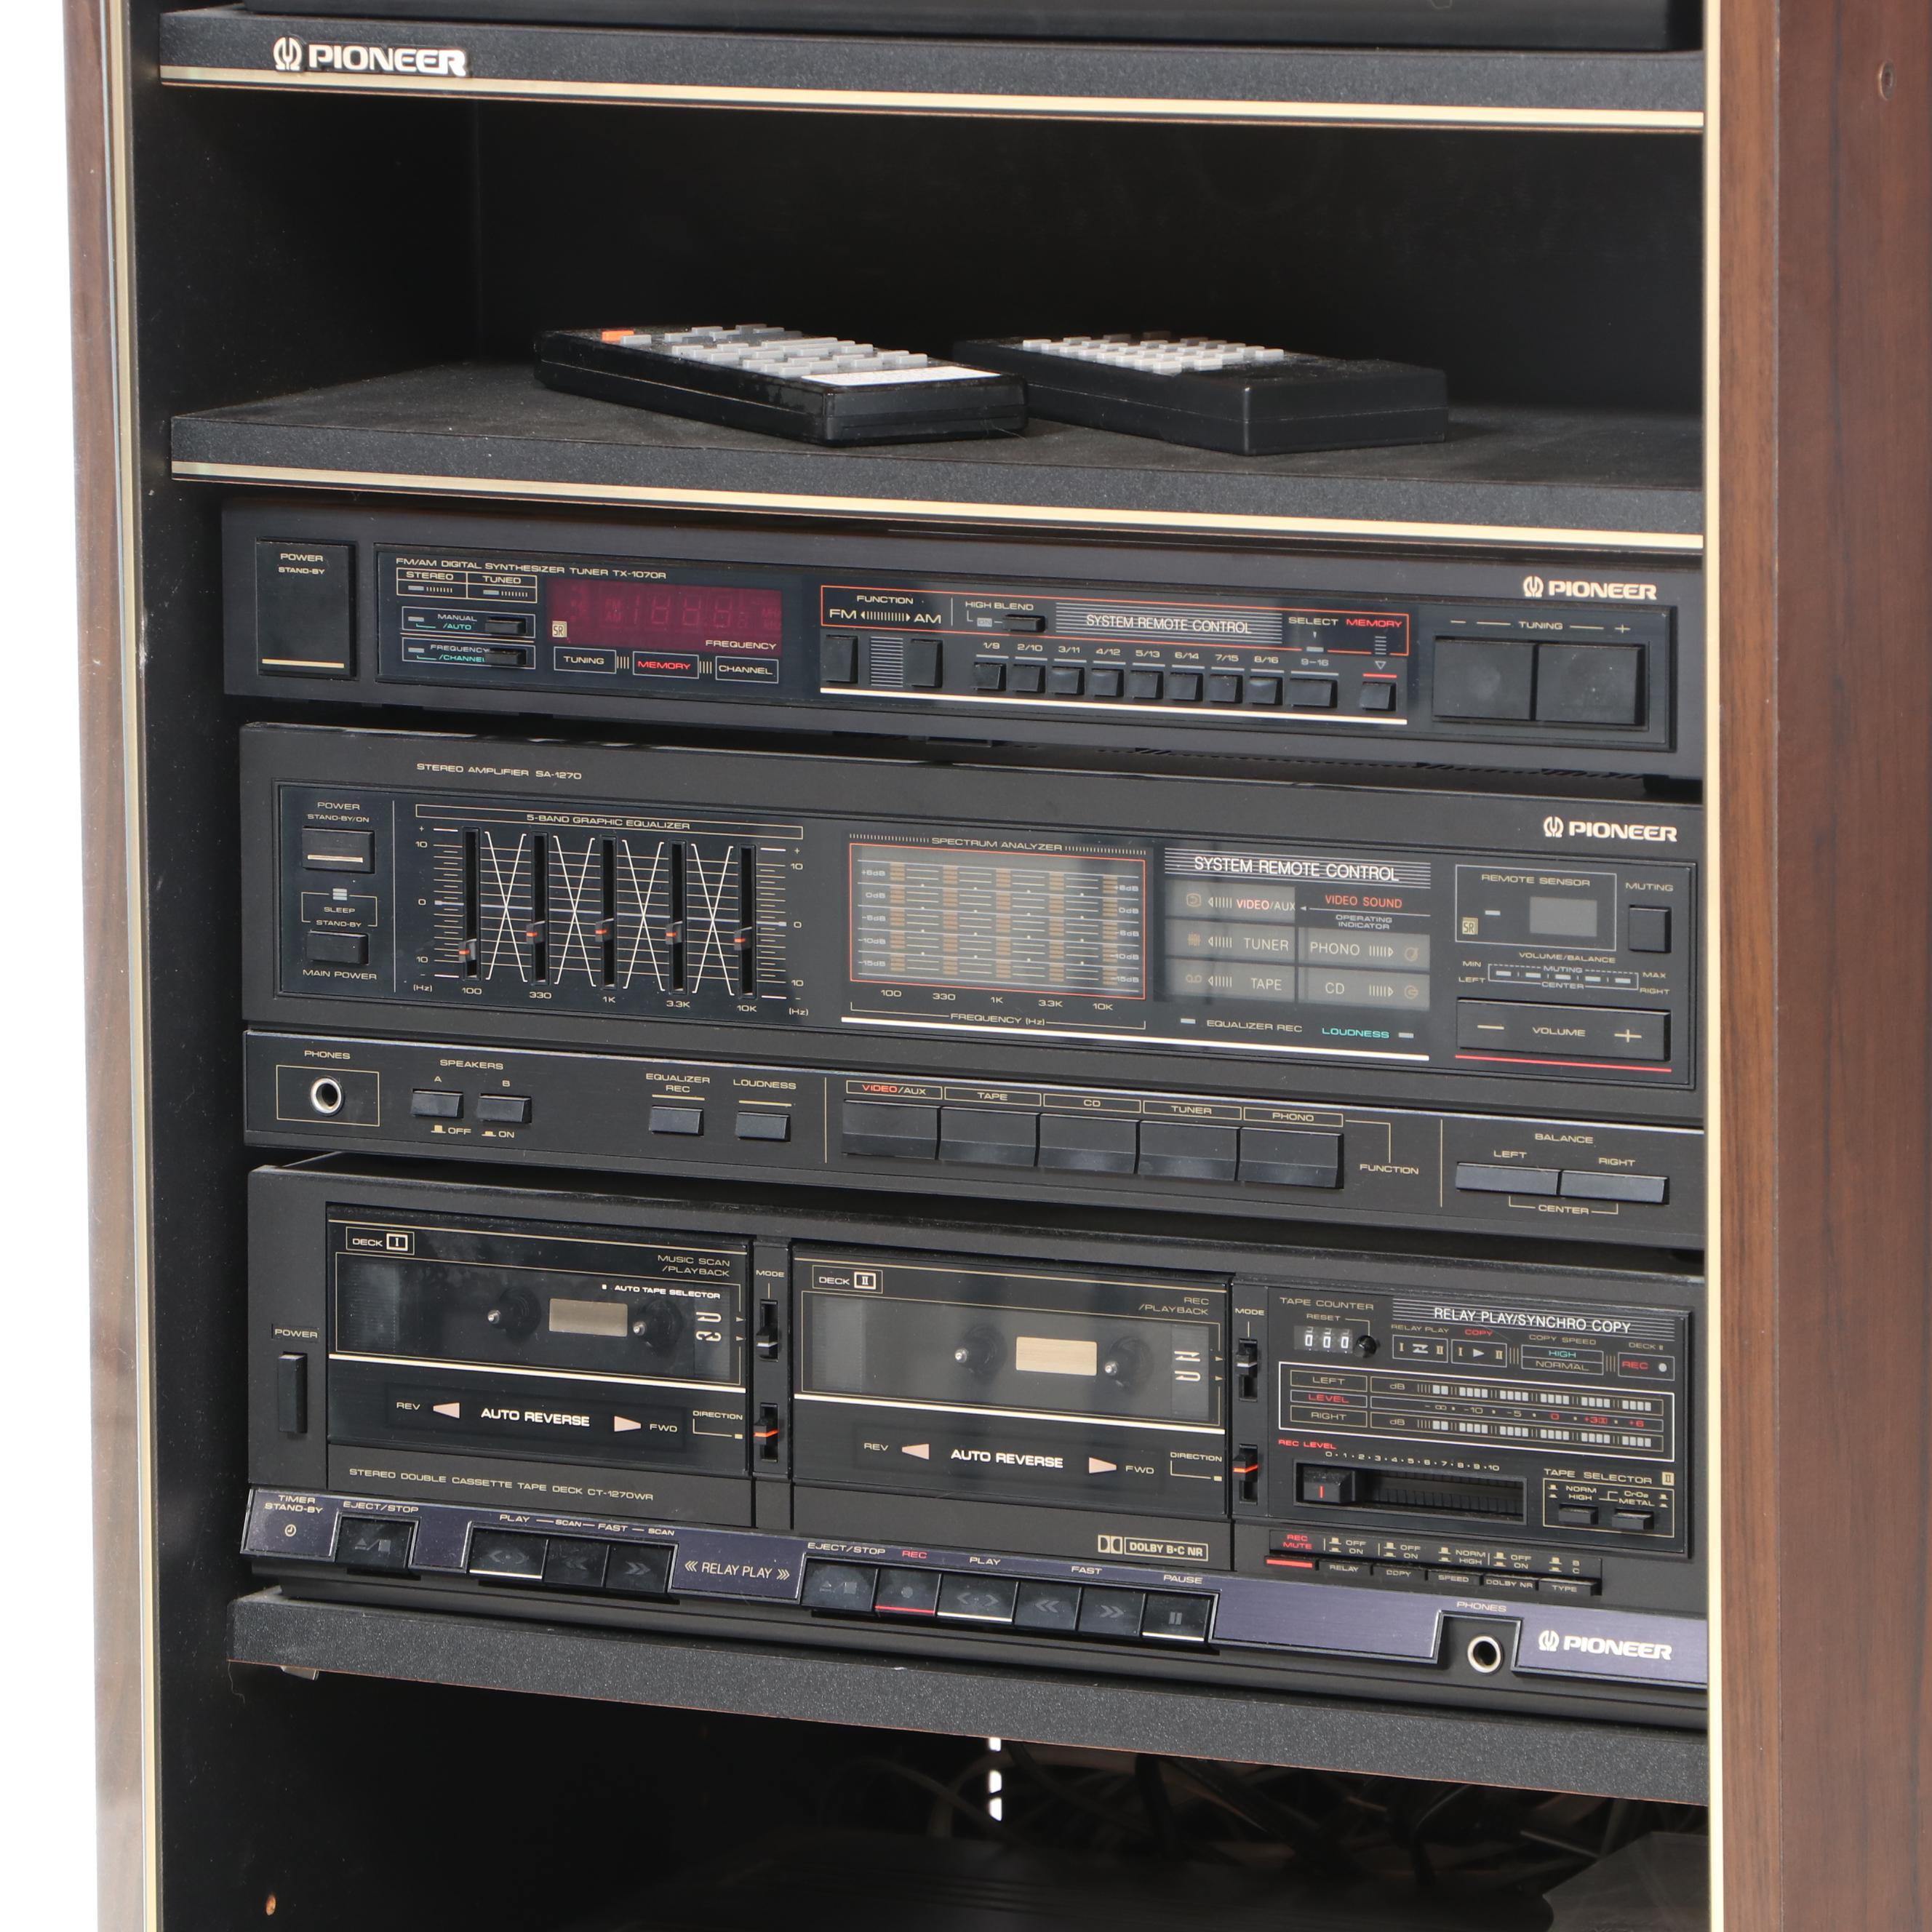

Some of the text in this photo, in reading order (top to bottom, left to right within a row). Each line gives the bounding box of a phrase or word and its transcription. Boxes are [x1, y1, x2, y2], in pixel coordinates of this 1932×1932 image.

[309, 44, 466, 76] PIONEER
[442, 561, 482, 569] DIGITAL
[485, 563, 564, 573] SYNTHESIZER
[570, 567, 608, 575] TUNER
[612, 570, 666, 579] TX-1070R
[406, 572, 453, 580] STEREO
[482, 576, 521, 584] TUNED
[1549, 580, 1657, 600] PIONEER
[857, 595, 913, 604] FUNCTION
[830, 609, 857, 618] FM
[914, 614, 941, 623] AM
[1087, 615, 1252, 634] SYSTEM REMOTE CONTROL
[1288, 617, 1338, 626] SELECT
[1346, 619, 1402, 627] MEMORY
[1518, 621, 1563, 630] TUNING
[431, 644, 490, 652] FREQUENCY
[706, 640, 777, 650] FREQUENCY
[1018, 644, 1042, 652] 2/10
[563, 656, 604, 664] TUNING
[638, 660, 691, 670] MEMORY
[719, 665, 773, 674] CHANNEL
[417, 764, 582, 780] STEREO AMPLIFIER SA-1270
[317, 802, 360, 810] POWER
[308, 814, 369, 822] STAND-BY/ON
[527, 815, 690, 829] 5-BAND GRAPHIC EQUALIZER
[1569, 821, 1677, 842] PIONEER
[931, 838, 1062, 851] SPECTRUM ANALYZER
[1194, 856, 1399, 881] SYSTEM REMOTE CONTROL
[1482, 874, 1590, 886] REMOTE SENSOR
[1626, 882, 1673, 891] MUTING
[1237, 898, 1295, 911] VIDEO/AUX
[1325, 895, 1402, 908] VIDEO SOUND
[1336, 914, 1392, 922] OPERATING
[1244, 938, 1288, 951] TUNER
[1310, 942, 1360, 956] PHONO
[1520, 952, 1616, 963] VOLUME/BALANCE
[335, 971, 377, 980] POWER
[1251, 978, 1282, 991] TAPE
[1325, 982, 1344, 994] CD
[951, 1013, 1021, 1024] FREQUENCY
[1207, 1020, 1302, 1033] EQUALIZER REC
[1322, 1028, 1389, 1038] LOUDNESS
[1533, 1027, 1586, 1037] VOLUME
[304, 1050, 351, 1059] PHONES
[440, 1059, 503, 1070] SPEAKERS
[646, 1073, 710, 1083] EQUALIZER
[666, 1085, 690, 1093] REC
[733, 1079, 797, 1090] LOUDNESS
[862, 1085, 926, 1095] VIDEO/AUX
[978, 1092, 1007, 1101] TAPE
[1171, 1106, 1212, 1114] TUNER
[1272, 1113, 1314, 1122] PHONO
[1535, 1133, 1594, 1143] BALANCE
[1599, 1158, 1635, 1166] RIGHT
[1360, 1164, 1419, 1174] FUNCTION
[1538, 1205, 1589, 1214] CENTER
[353, 1238, 383, 1247] DECK
[658, 1255, 730, 1266] MUSIC SCAN
[662, 1266, 729, 1277] /PLAYBACK
[819, 1277, 850, 1285] DECK
[669, 1290, 720, 1298] SELECTOR
[1184, 1297, 1209, 1305] REC
[1280, 1298, 1374, 1310] TAPE COUNTER
[1138, 1304, 1208, 1315] /PLAYBACK
[1434, 1307, 1631, 1333] RELAY PLAY/SYNCHRO COPY
[275, 1329, 317, 1338] POWER
[1391, 1324, 1421, 1333] RELAY
[1562, 1337, 1596, 1345] SPEED
[1309, 1394, 1349, 1403] LEVEL
[481, 1408, 590, 1426] AUTO REVERSE
[692, 1410, 743, 1420] DIRECTION
[650, 1424, 677, 1432] FWD
[864, 1443, 888, 1451] REV
[951, 1450, 1063, 1469] AUTO REVERSE
[1170, 1452, 1222, 1462] DIRECTION
[1126, 1466, 1154, 1474] FWD
[1544, 1469, 1653, 1484] TAPE SELECTOR
[349, 1469, 653, 1500] STEREO DOUBLE CASSETTE TAPE DECK CT-1270WR
[278, 1496, 315, 1504] TIMER
[264, 1503, 323, 1513] STAND-BY
[343, 1501, 418, 1513] EJECT/STOP
[500, 1514, 530, 1522] PLAY
[598, 1523, 628, 1531] FAST
[807, 1543, 885, 1554] EJECT/STOP
[1130, 1542, 1163, 1553] DOLBY
[1187, 1547, 1203, 1557] NR
[902, 1550, 927, 1559] REC
[970, 1557, 1001, 1565] PLAY
[702, 1562, 773, 1579] RELAY PLAY
[1071, 1566, 1102, 1574] FAST
[1164, 1575, 1203, 1584] PAUSE
[1456, 1602, 1506, 1612] PHONES
[1564, 1636, 1672, 1660] PIONEER
